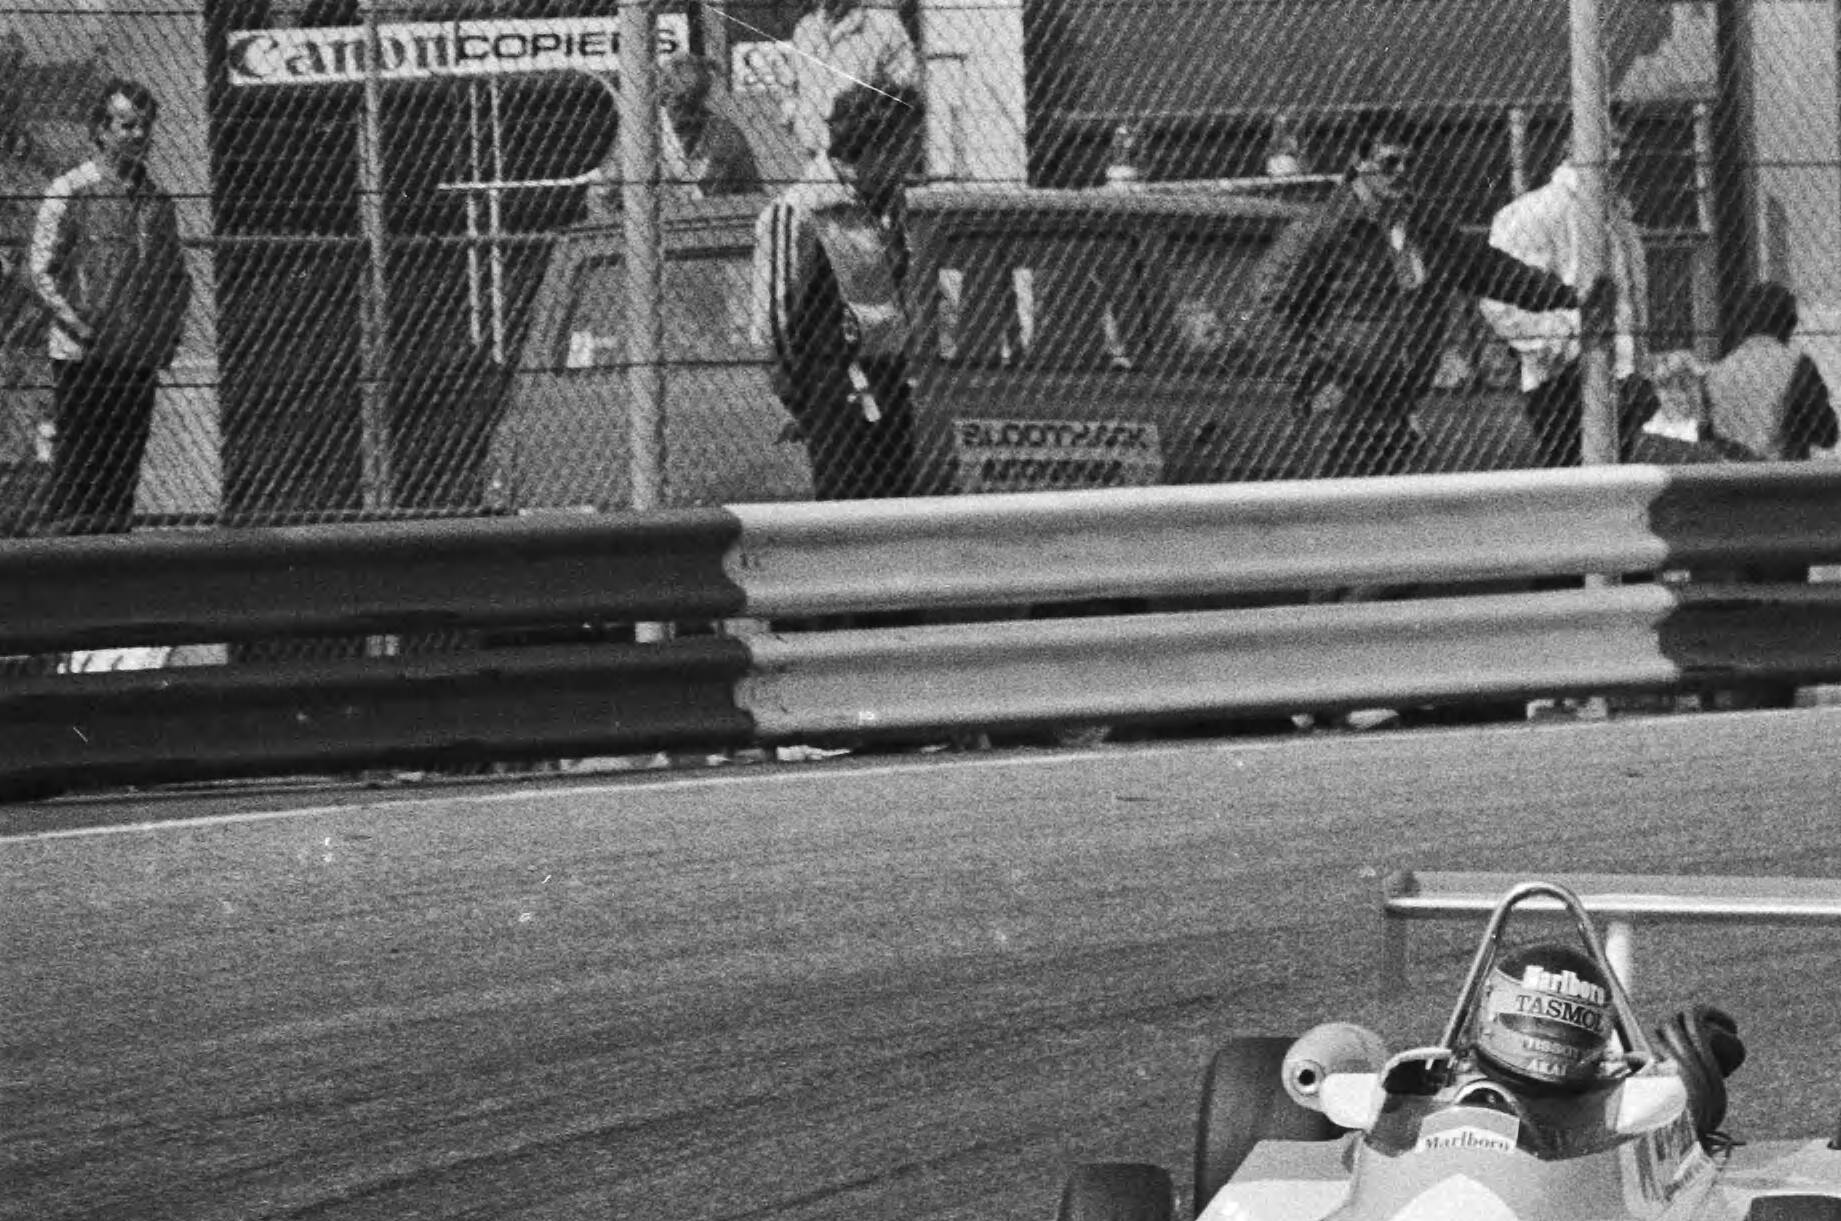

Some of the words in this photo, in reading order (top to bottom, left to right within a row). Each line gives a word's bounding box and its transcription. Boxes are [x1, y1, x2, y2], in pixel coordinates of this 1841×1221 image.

[229, 34, 450, 77] Canon
[458, 28, 677, 60] COPIES
[1425, 1131, 1509, 1151] Marlboro
